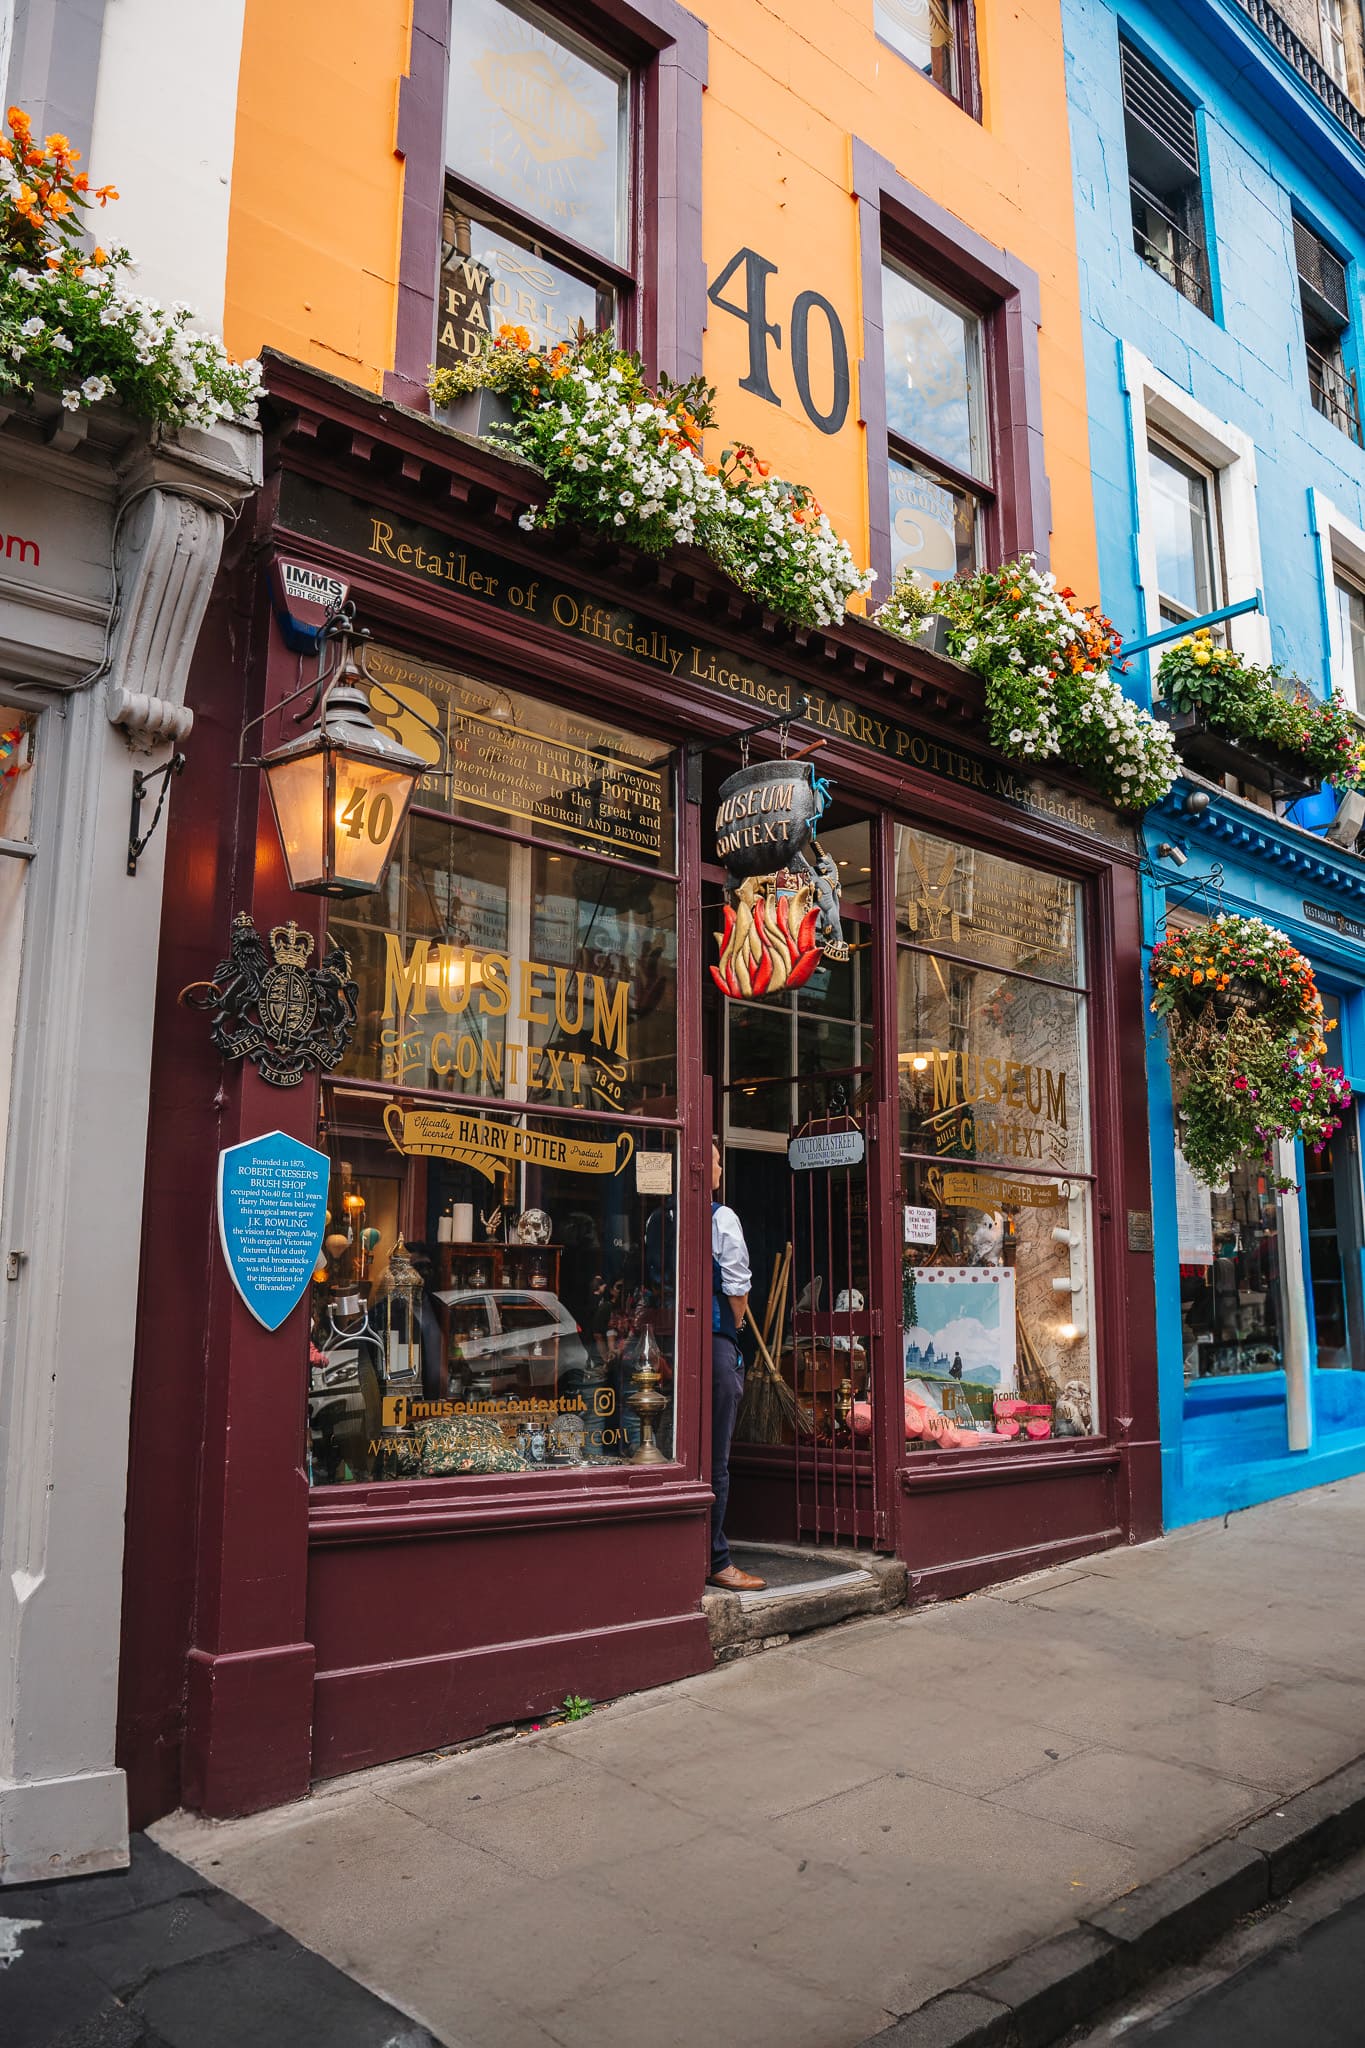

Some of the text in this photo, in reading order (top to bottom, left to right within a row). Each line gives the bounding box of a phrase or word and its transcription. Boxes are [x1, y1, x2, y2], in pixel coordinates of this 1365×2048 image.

[707, 247, 850, 436] 40
[287, 565, 342, 595] IMMS
[367, 655, 455, 695] Superior
[368, 519, 1096, 831] Retailer of Officially Licensed HARRY POTTER Merchandise
[456, 715, 662, 795] The original and best purveyors
[455, 737, 662, 812] of official HARRY POTTER
[454, 758, 544, 794] merchandise
[550, 785, 564, 800] to
[571, 791, 592, 809] the
[599, 801, 632, 822] great
[639, 813, 661, 830] and
[341, 787, 394, 845] 40
[454, 777, 488, 798] good
[492, 786, 508, 801] of
[512, 791, 582, 825] EDINBURGH
[587, 818, 611, 833] AND
[614, 824, 661, 848] BEYOND!
[716, 819, 790, 859] CONTEXT
[381, 933, 631, 1062] MUSEUM
[232, 1034, 339, 1084] DIEU ET MON DROIT
[385, 1042, 422, 1068] BUILT
[431, 1032, 586, 1093] CONTEXT
[595, 1070, 621, 1099] 1840
[932, 1047, 1066, 1131] MUSEUM
[413, 1115, 451, 1131] Officially
[421, 1128, 454, 1140] licensed
[459, 1120, 567, 1164] HARRY POTTER
[797, 1134, 856, 1154] VICTORIA STREET
[936, 1126, 956, 1147] BUILT
[960, 1118, 1045, 1159] CONTEXT
[252, 1157, 281, 1167] Founded
[570, 1145, 604, 1160] Products
[807, 1149, 845, 1160] EDINBURGH
[238, 1166, 318, 1180] ROBERT CRESSER'S
[578, 1158, 600, 1168] inside
[230, 1188, 260, 1198] occupied
[261, 1189, 281, 1198] No.40
[281, 1190, 291, 1199] for
[293, 1191, 304, 1199] 131
[250, 1178, 306, 1190] BRUSH SHOP
[238, 1197, 316, 1209] Harry Potter fans believe
[240, 1207, 314, 1218] this magical street gave
[232, 1227, 244, 1235] the
[245, 1228, 264, 1236] vision
[265, 1228, 276, 1236] for
[276, 1229, 299, 1238] Diagon
[248, 1217, 308, 1228] J.K. ROWLING
[240, 1237, 312, 1247] With original Victorian
[242, 1246, 268, 1254] fixtures
[268, 1246, 280, 1254] full
[289, 1247, 307, 1256] dusty
[237, 1255, 309, 1265] boxes and broomsticks
[260, 1265, 273, 1273] this
[273, 1265, 288, 1273] little
[289, 1266, 305, 1275] shop
[247, 1274, 303, 1284] the inspiration for
[254, 1283, 296, 1292] Ollivanders?
[411, 1395, 588, 1417] museumcontextuk
